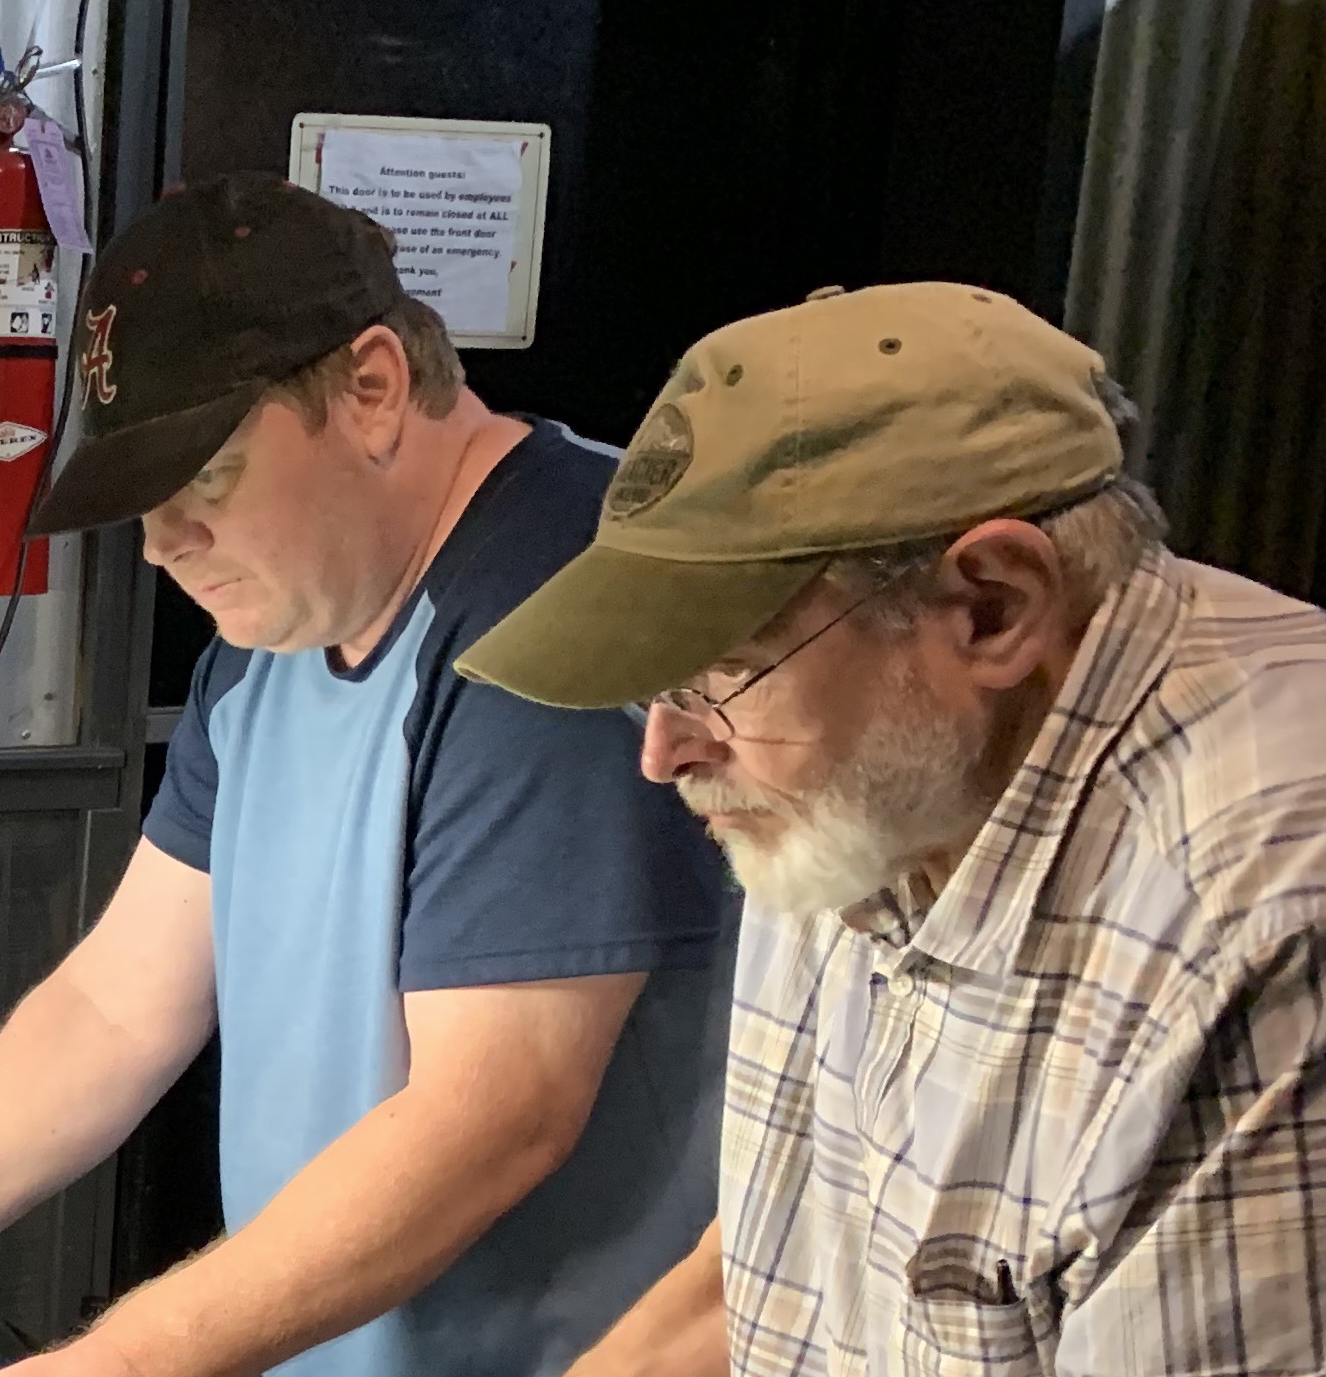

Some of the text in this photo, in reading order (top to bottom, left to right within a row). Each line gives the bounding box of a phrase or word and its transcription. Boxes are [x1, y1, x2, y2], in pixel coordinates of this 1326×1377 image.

[379, 166, 426, 178] Attention
[329, 185, 512, 205] This door is to be used by employees
[381, 205, 391, 216] is
[393, 207, 403, 217] to
[406, 208, 440, 218] remain
[442, 210, 474, 220] closed
[476, 211, 487, 220] at
[489, 211, 509, 221] ALL
[411, 227, 427, 236] use
[430, 227, 445, 237] the
[448, 228, 471, 238] front
[474, 229, 497, 239] door
[419, 245, 430, 254] of
[431, 246, 443, 254] an
